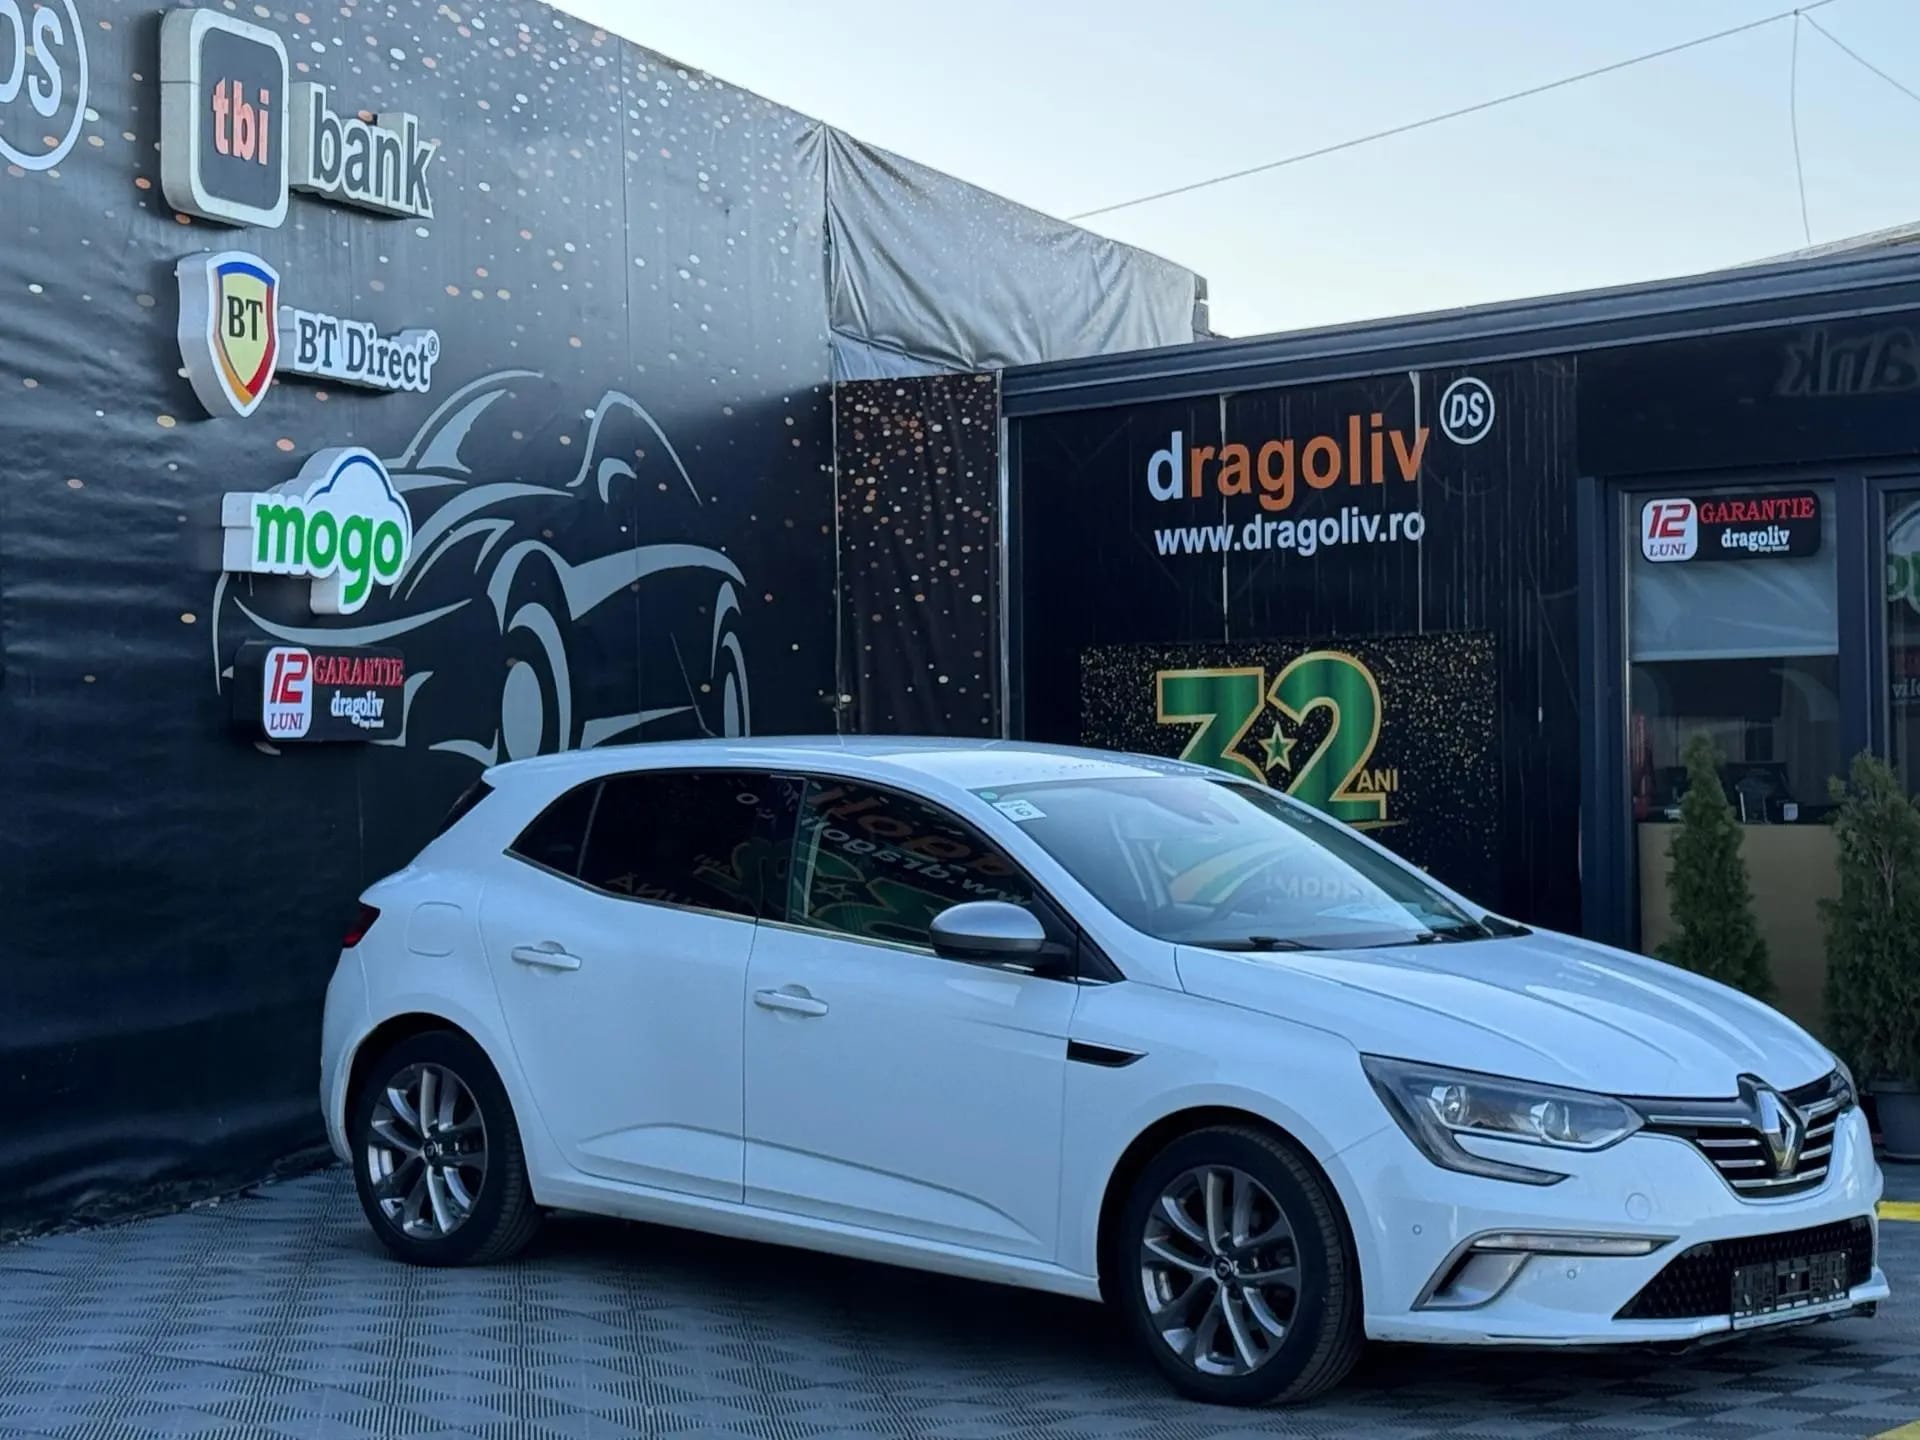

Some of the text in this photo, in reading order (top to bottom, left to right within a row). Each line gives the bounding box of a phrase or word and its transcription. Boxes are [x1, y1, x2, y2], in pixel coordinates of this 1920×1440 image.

[213, 77, 432, 212] tbi bank
[227, 295, 263, 341] BT
[298, 317, 337, 368] BT
[1147, 393, 1485, 511] dragoliv DS
[1648, 503, 1691, 539] 12
[1700, 497, 1815, 524] GARANTIE
[1154, 508, 1425, 556] www.dragoliv.ro
[1649, 543, 1687, 557] LUNI
[1721, 525, 1790, 551] dragoliv
[256, 504, 403, 605] mogo
[270, 653, 309, 704] 12
[313, 655, 404, 687] GARANTIE
[270, 713, 304, 731] LUNI
[331, 690, 385, 725] dragoliv
[1156, 651, 1387, 822] 32
[1357, 769, 1399, 793] ANI
